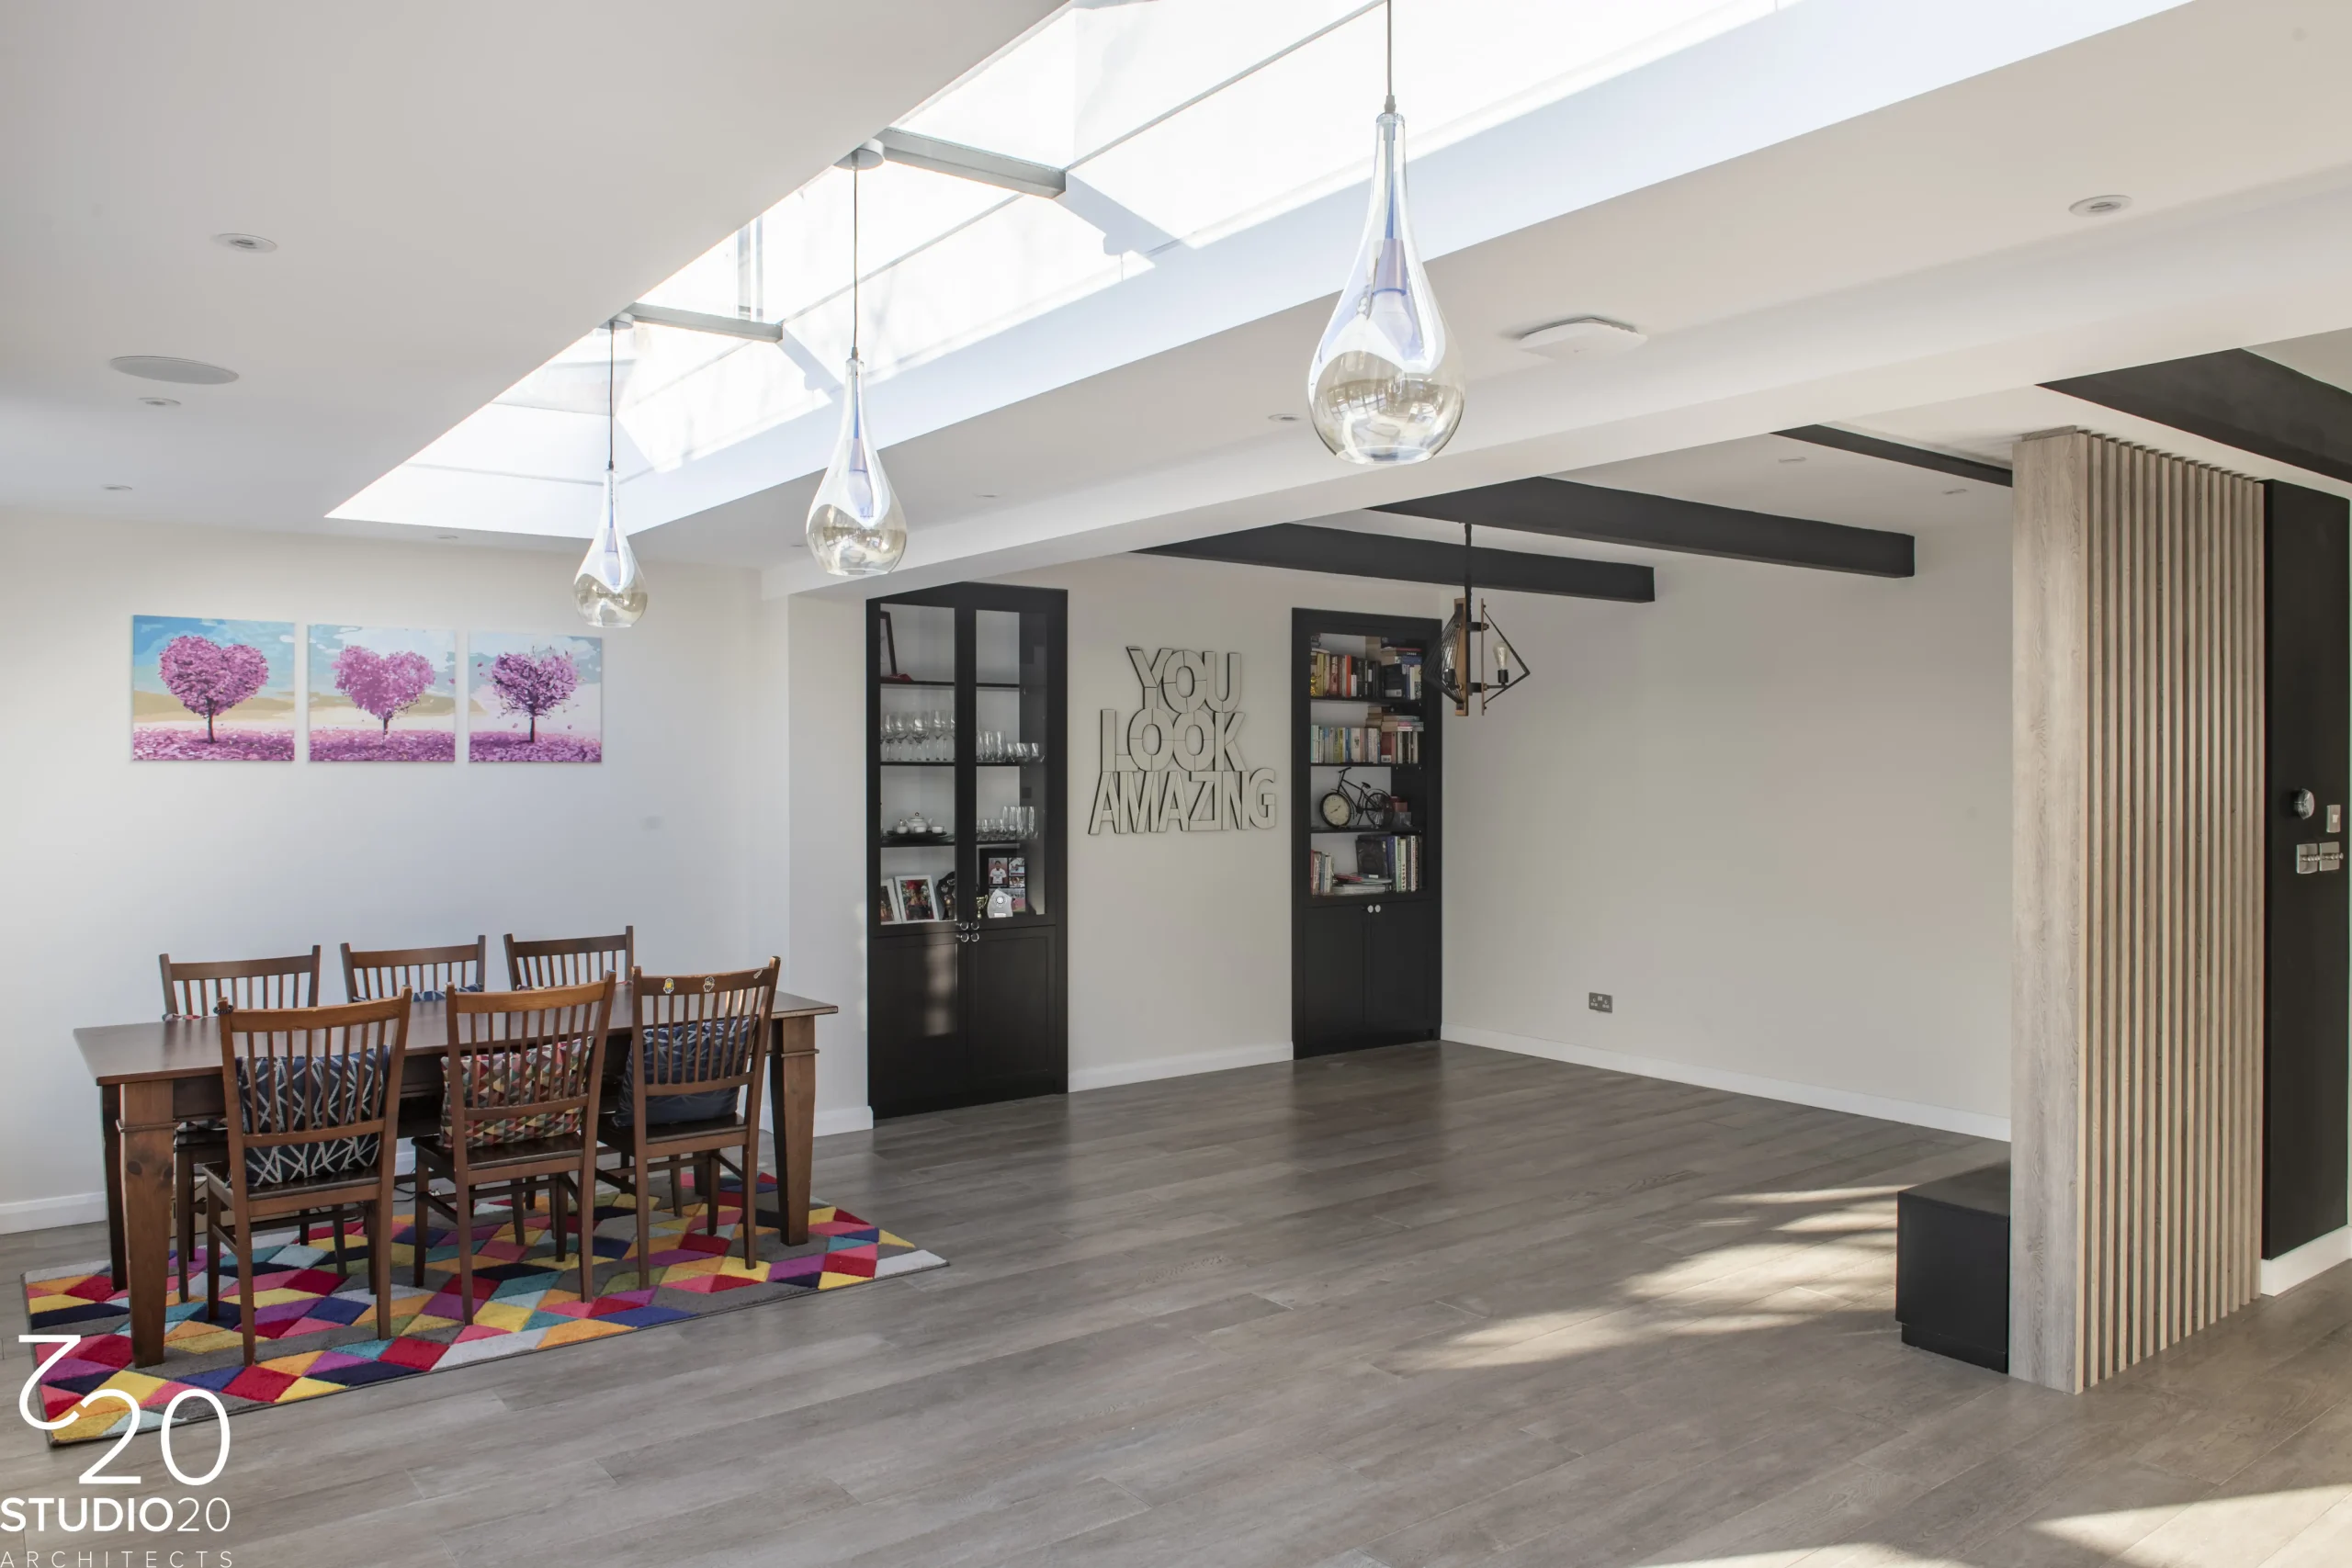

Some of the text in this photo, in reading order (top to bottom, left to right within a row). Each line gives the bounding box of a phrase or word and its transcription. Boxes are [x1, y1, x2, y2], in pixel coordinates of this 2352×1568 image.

[1126, 647, 1241, 713] YOU
[1101, 708, 1246, 772] LOOK
[1088, 768, 1275, 835] AMAZING
